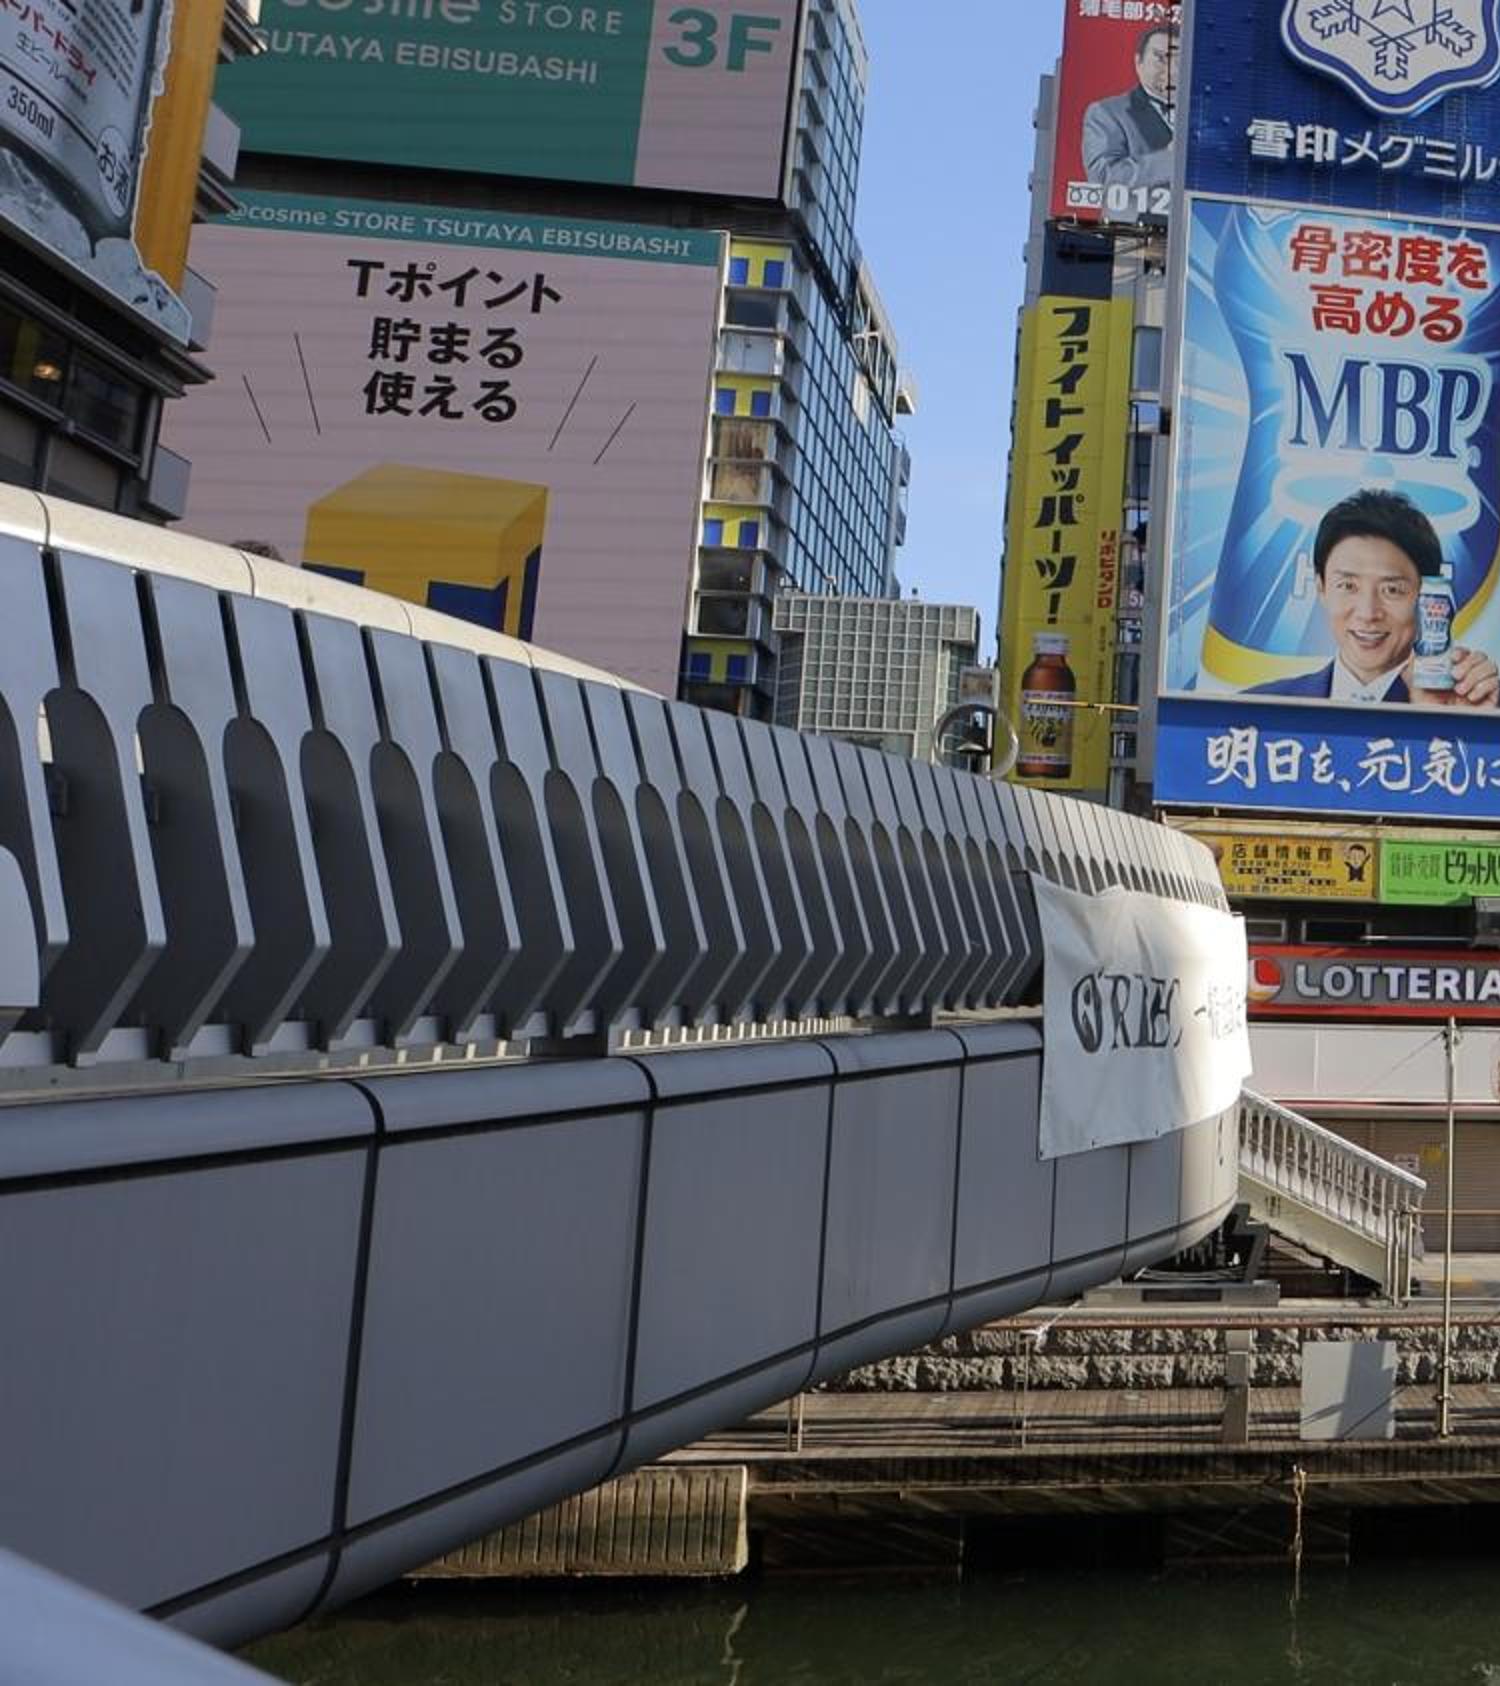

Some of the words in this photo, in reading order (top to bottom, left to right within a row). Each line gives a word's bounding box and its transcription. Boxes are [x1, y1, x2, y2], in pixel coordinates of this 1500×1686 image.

[499, 0, 623, 35] STORE
[661, 8, 781, 73] 3F
[395, 41, 598, 84] EBISUBASHI
[7, 85, 55, 139] 350ml
[334, 209, 416, 234] STORE
[423, 218, 535, 244] TSUTAYA
[541, 227, 693, 258] EBISUBASHI
[1288, 223, 1489, 291] 骨密度を
[346, 258, 564, 315] Tポイント
[1309, 282, 1463, 344] 高める
[367, 316, 525, 370] 貯まる
[362, 369, 519, 424] 使える
[1283, 352, 1482, 459] MBP
